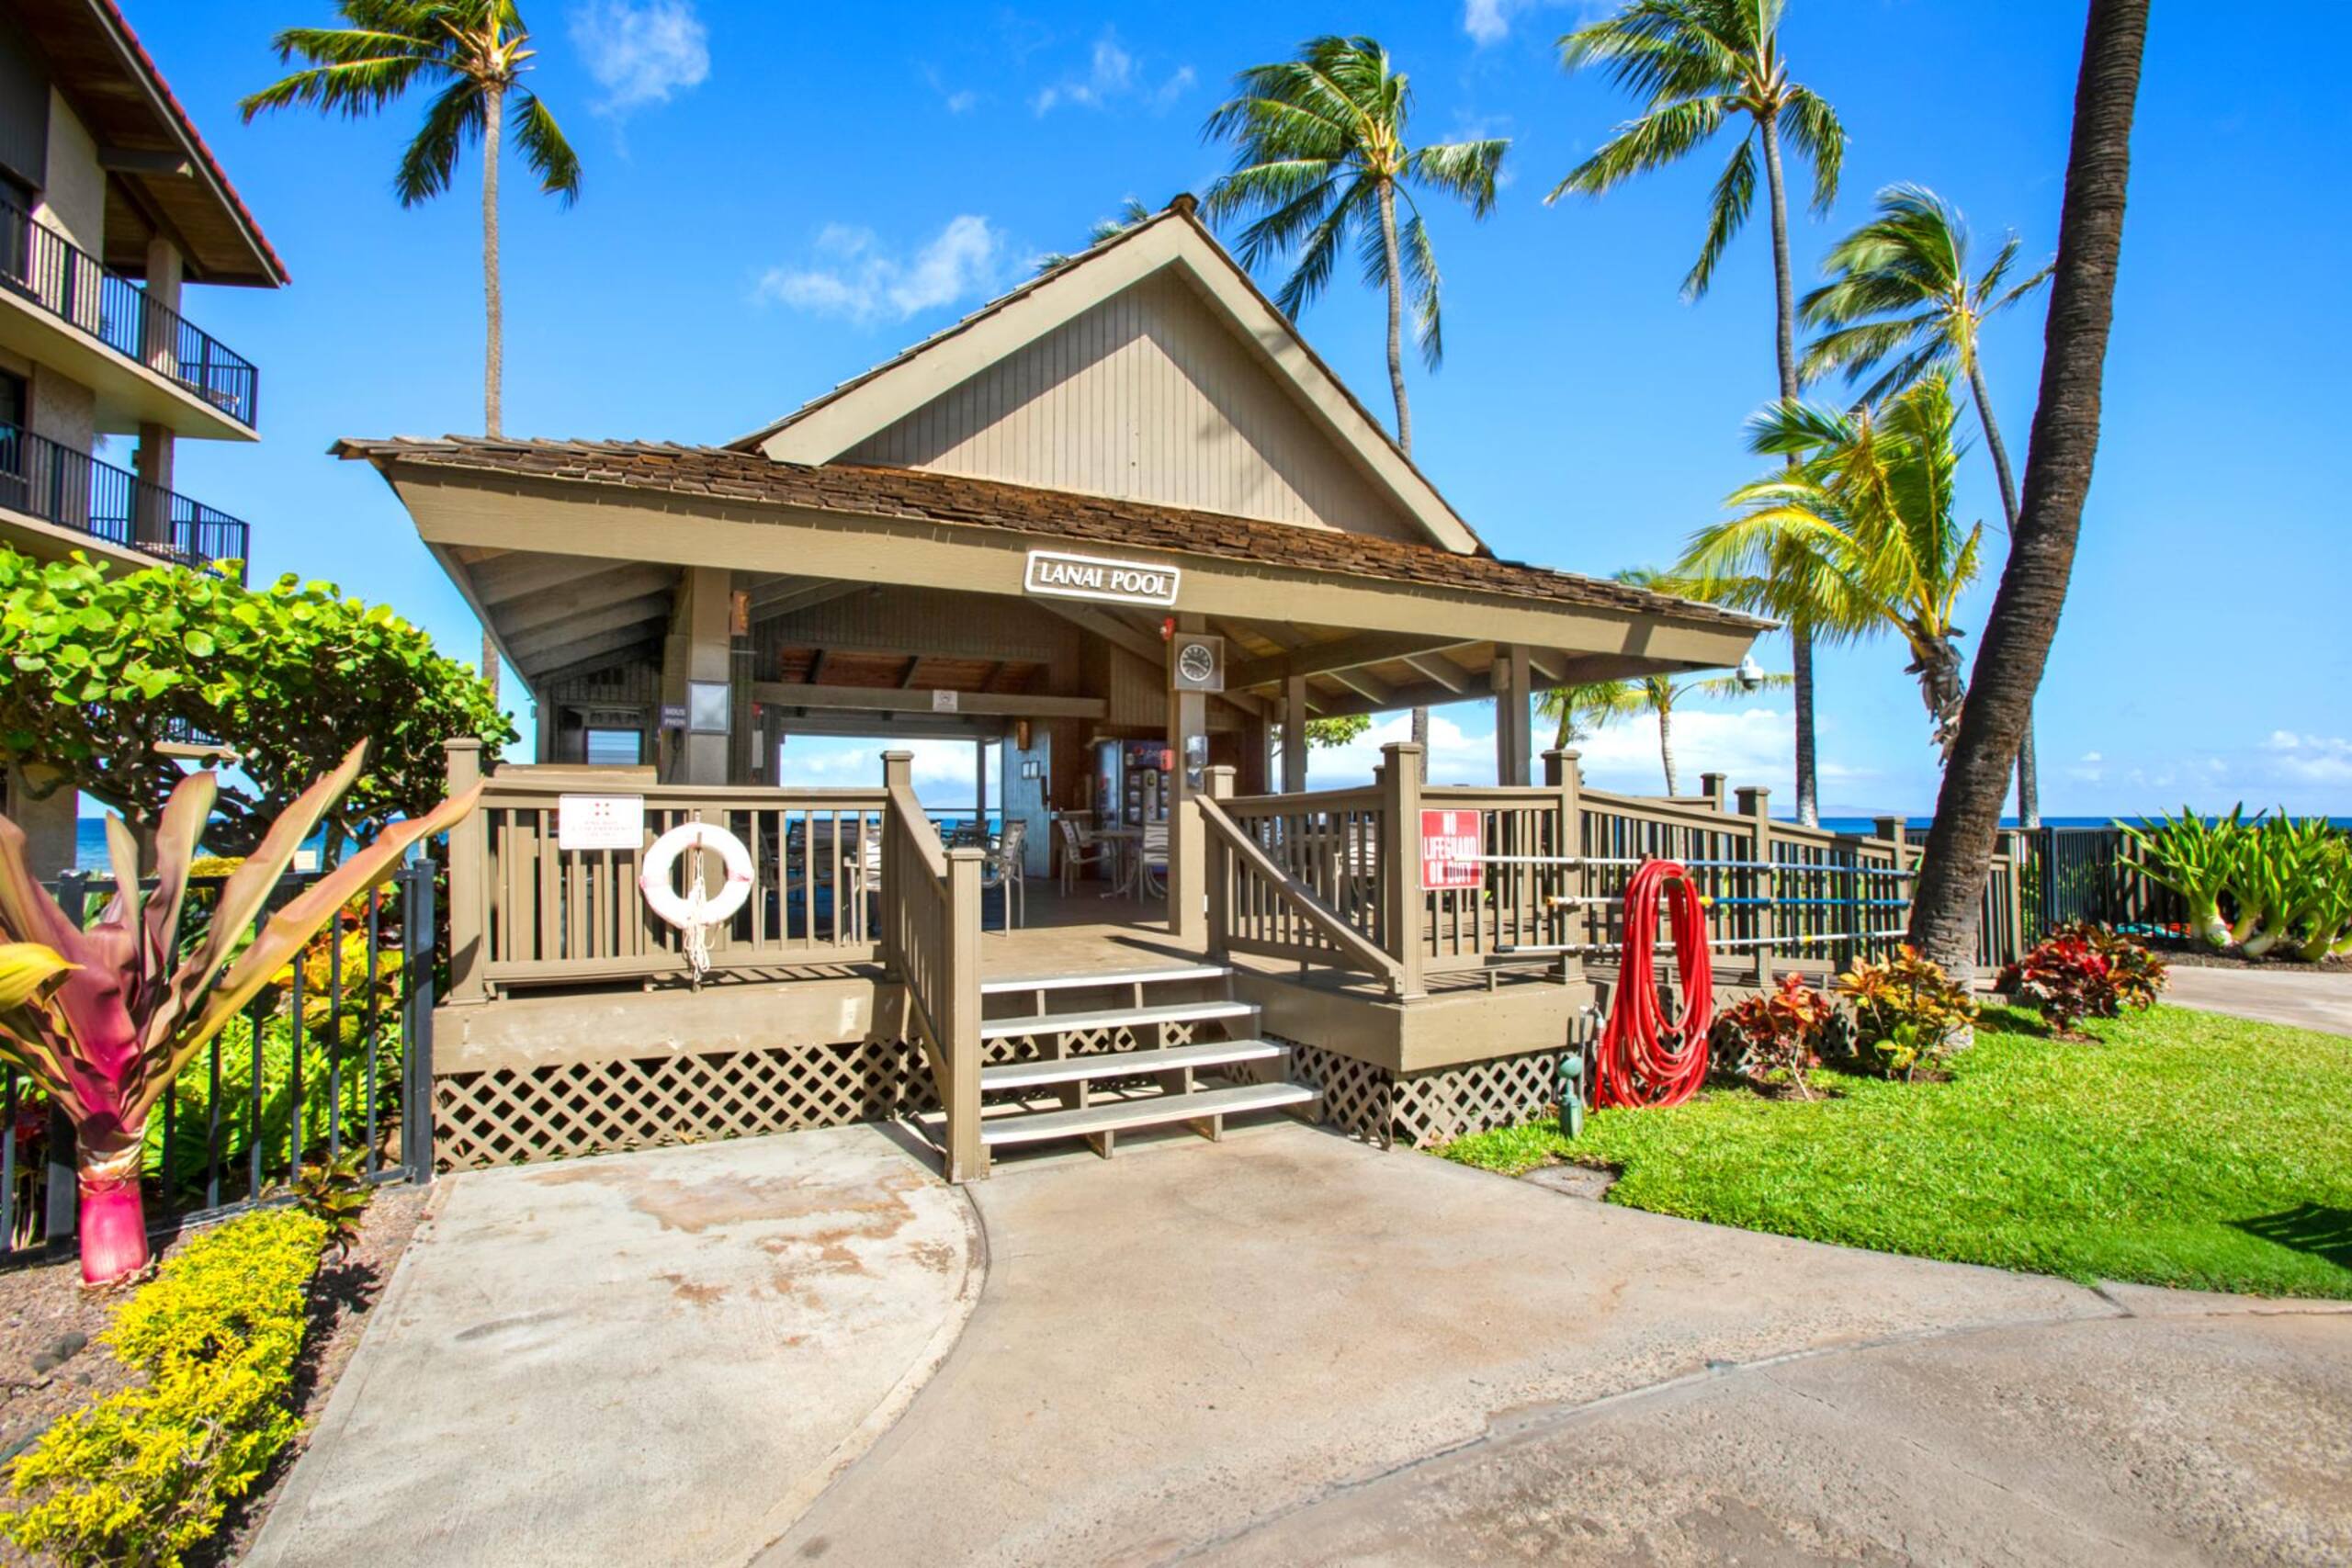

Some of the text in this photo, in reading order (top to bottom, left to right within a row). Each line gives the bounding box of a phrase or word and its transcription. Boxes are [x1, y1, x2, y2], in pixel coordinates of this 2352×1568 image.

[1039, 562, 1168, 595] LANAI POOL
[1442, 812, 1457, 835] NO
[1423, 836, 1477, 860] LIFEGUARD
[1429, 861, 1444, 884] ON
[1447, 861, 1473, 884] DUTY
